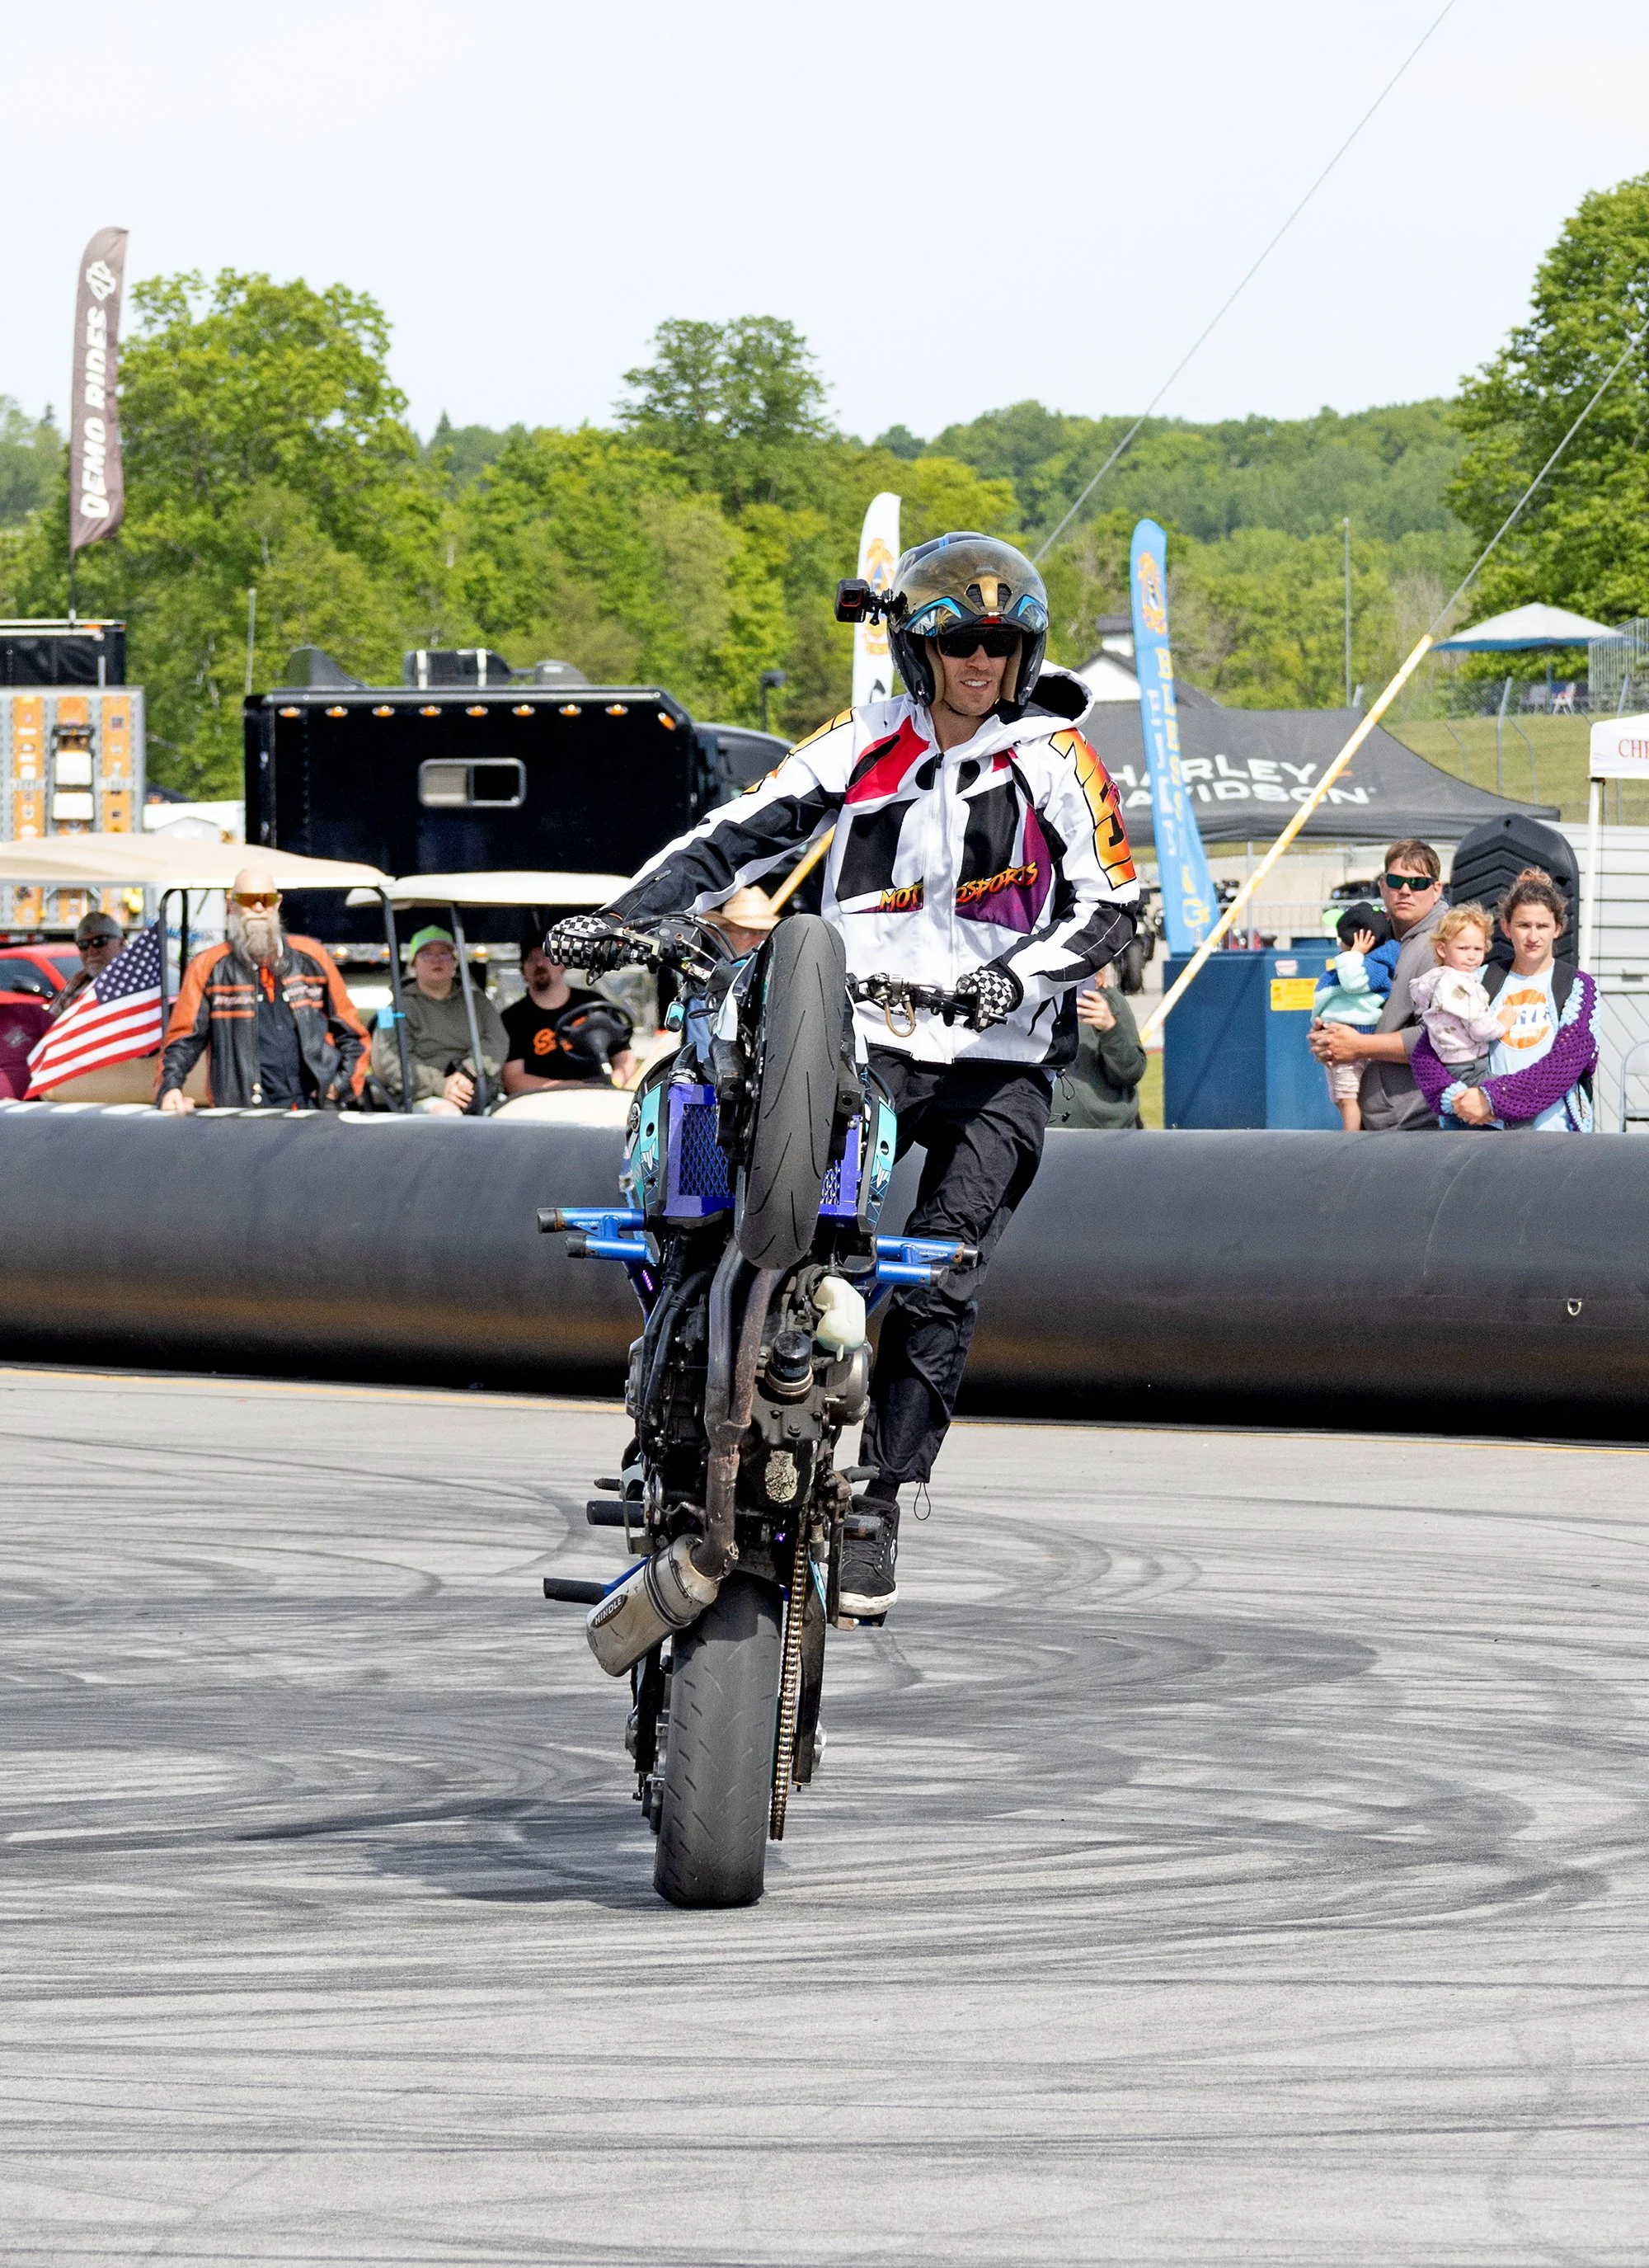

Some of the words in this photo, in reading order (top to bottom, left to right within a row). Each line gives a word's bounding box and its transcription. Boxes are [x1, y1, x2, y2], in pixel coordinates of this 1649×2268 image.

[85, 306, 106, 409] RIDES
[80, 416, 109, 518] DEMO
[594, 1596, 622, 1626] HINDLE
